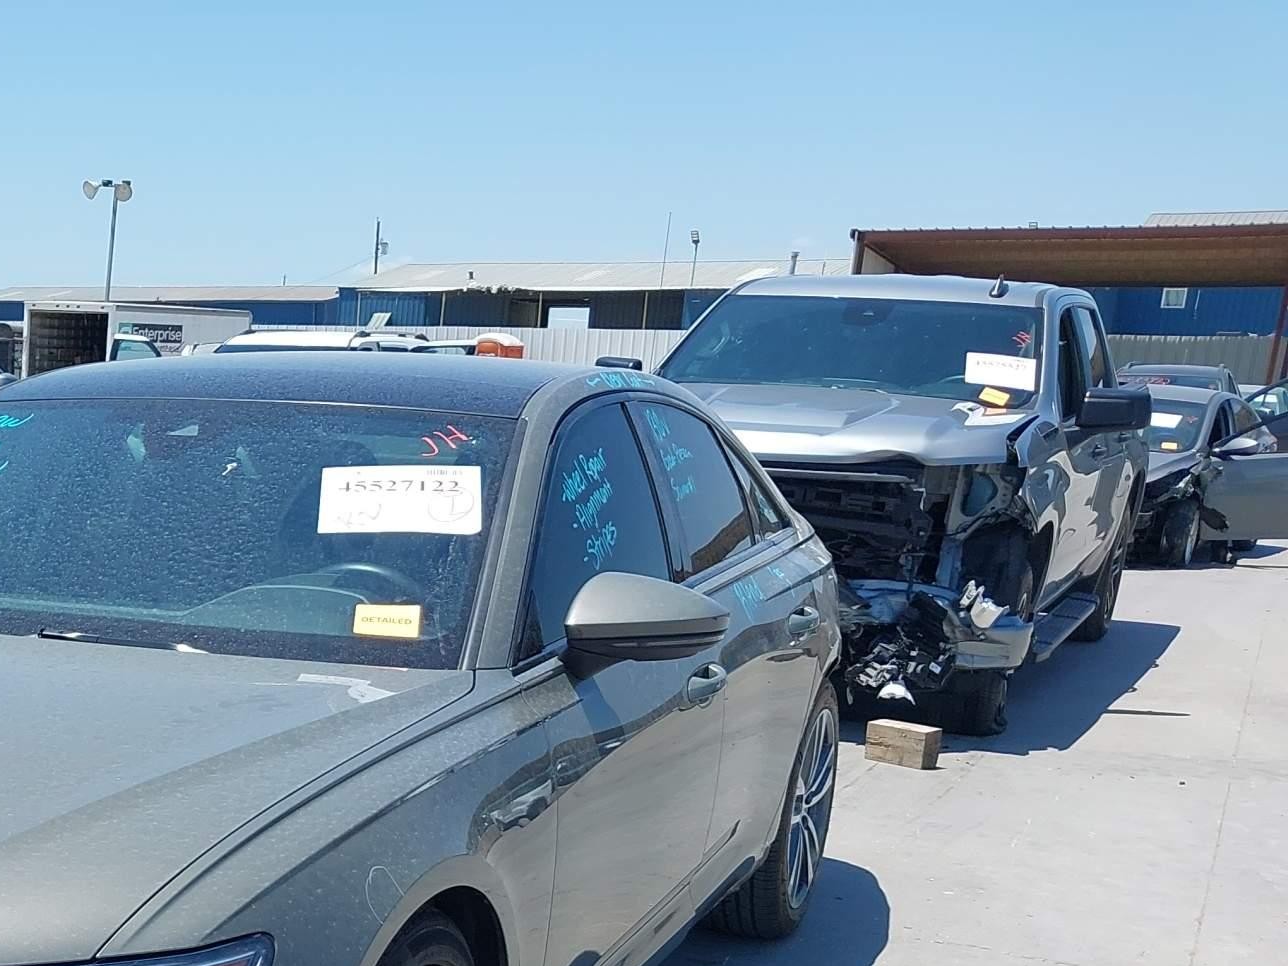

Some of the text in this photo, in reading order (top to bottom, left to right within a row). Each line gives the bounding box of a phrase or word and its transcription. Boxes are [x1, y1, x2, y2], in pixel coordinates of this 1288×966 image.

[132, 326, 182, 343] Enterprise
[338, 479, 461, 493] 45527122
[361, 616, 413, 625] DETAILED
